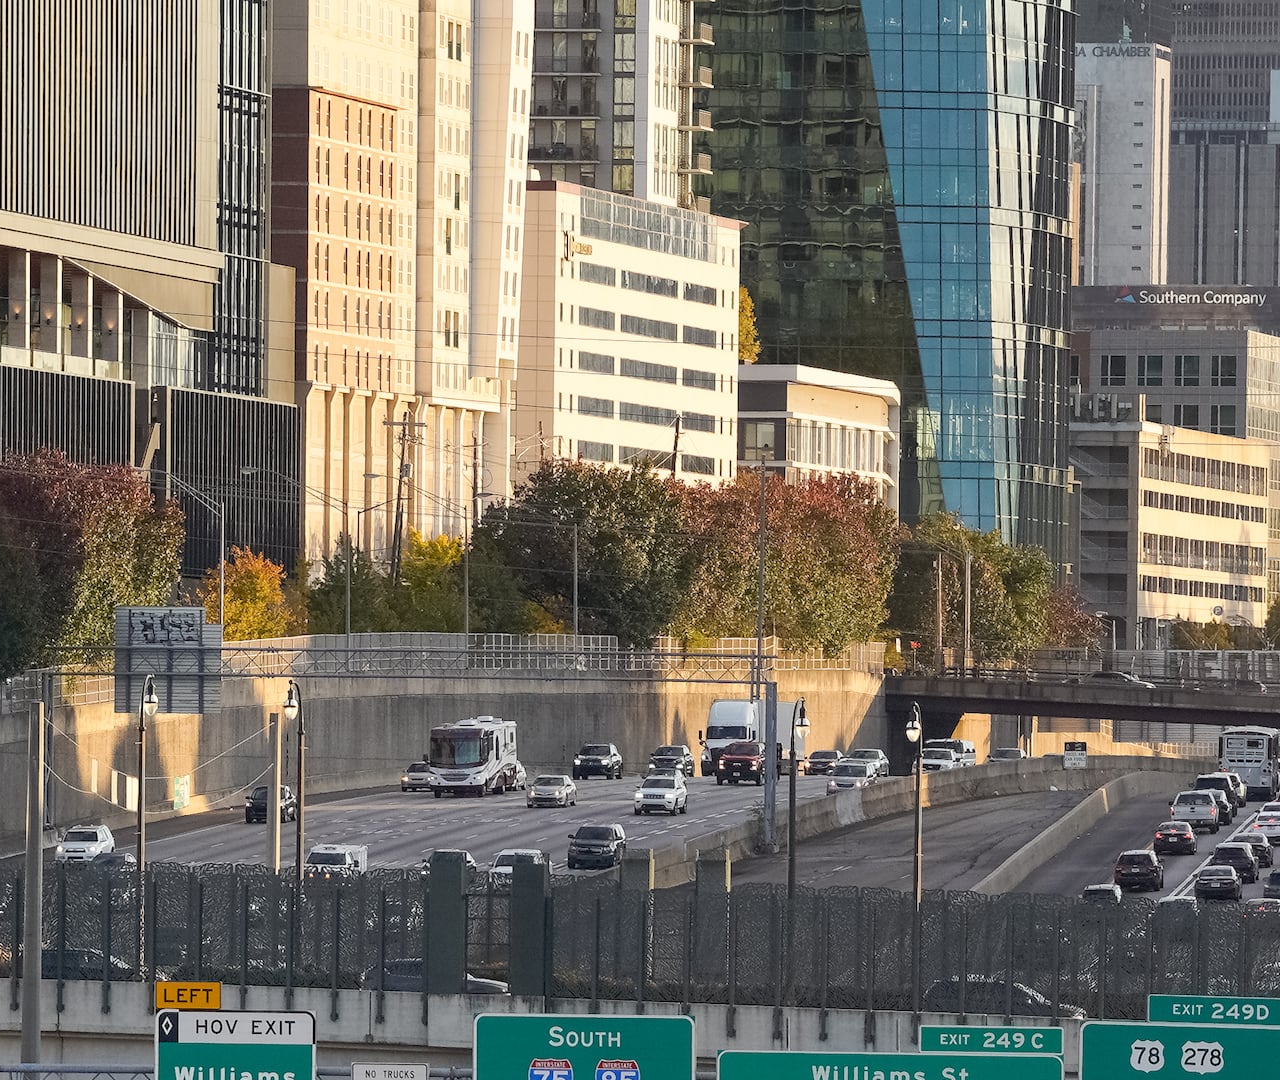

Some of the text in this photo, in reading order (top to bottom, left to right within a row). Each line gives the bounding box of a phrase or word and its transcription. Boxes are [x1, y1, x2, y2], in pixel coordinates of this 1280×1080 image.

[1092, 46, 1151, 58] CHAMBER
[1139, 290, 1267, 307] Southern Company
[163, 988, 213, 1004] LEFT
[1172, 1002, 1269, 1020] EXIT 249D
[195, 1019, 296, 1036] HOV EXIT
[939, 1033, 970, 1046] EXIT
[1134, 1046, 1222, 1067] 78 278
[535, 1061, 633, 1069] INTERSTATE INTERSTATE
[365, 1069, 415, 1080] NO TRUCKS
